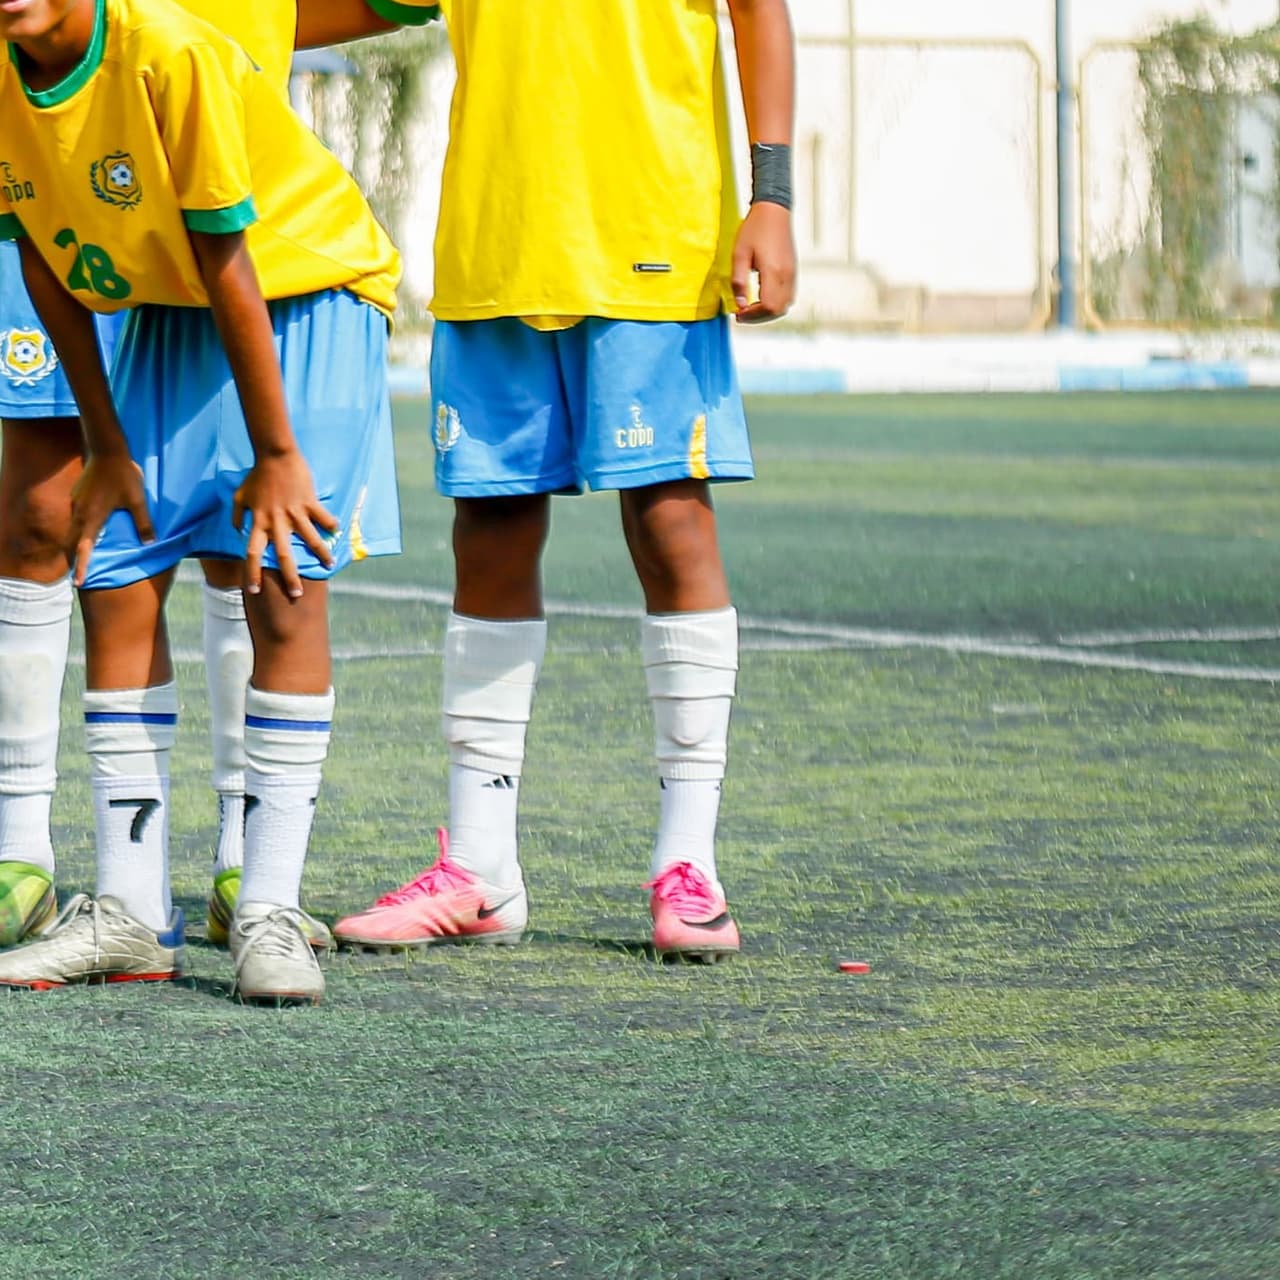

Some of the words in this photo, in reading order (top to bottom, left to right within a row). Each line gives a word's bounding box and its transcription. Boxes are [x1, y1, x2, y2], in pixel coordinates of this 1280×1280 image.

[53, 228, 132, 300] 28
[616, 427, 654, 449] COPA
[109, 797, 162, 844] 7
